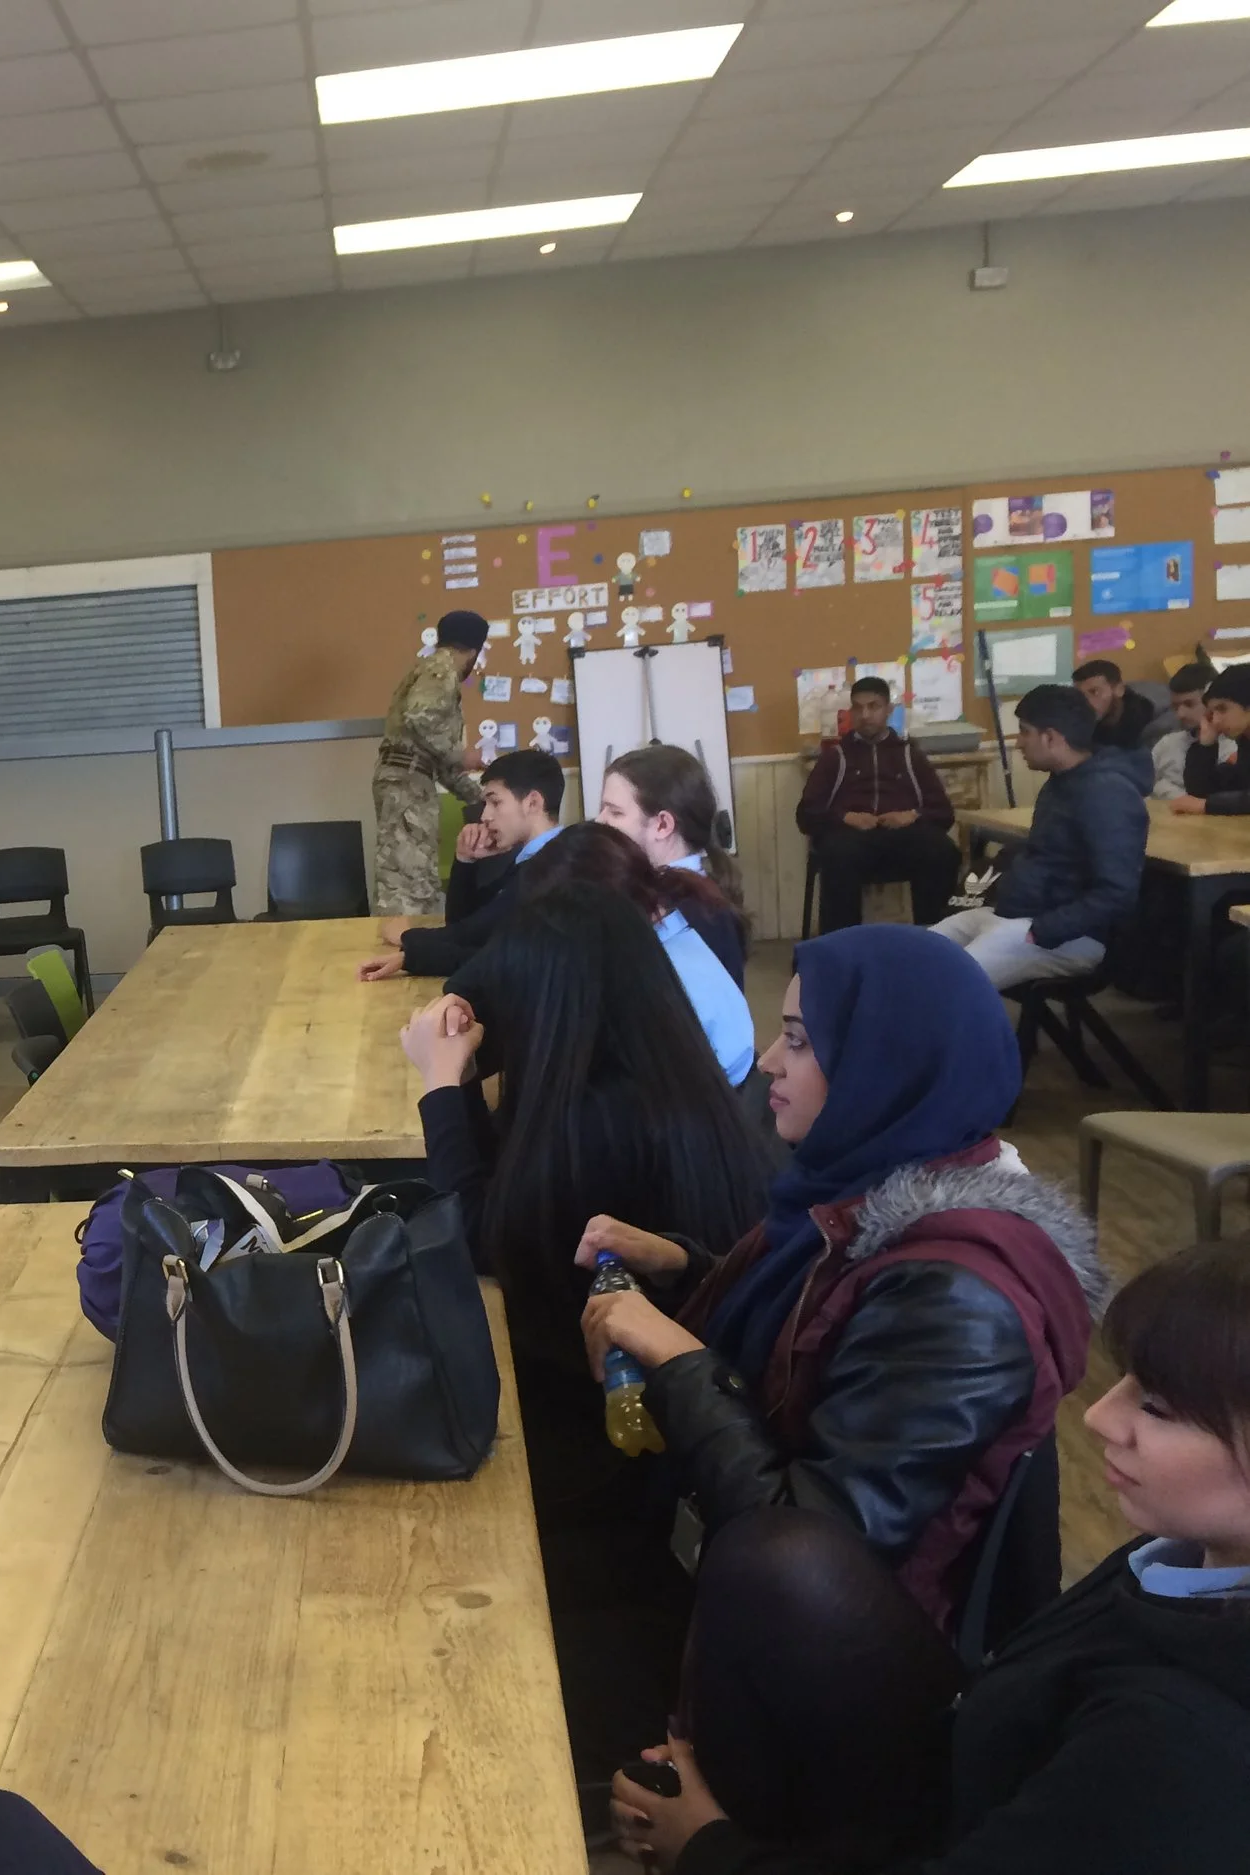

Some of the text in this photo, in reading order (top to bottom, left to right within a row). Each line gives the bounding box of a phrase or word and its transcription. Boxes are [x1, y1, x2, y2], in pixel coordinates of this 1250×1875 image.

[751, 530, 758, 562] 1
[802, 526, 819, 570] 2
[862, 518, 878, 555] 3
[921, 513, 938, 549] 4
[537, 525, 578, 587] E
[514, 586, 605, 609] EFFORT
[920, 586, 936, 621] 5
